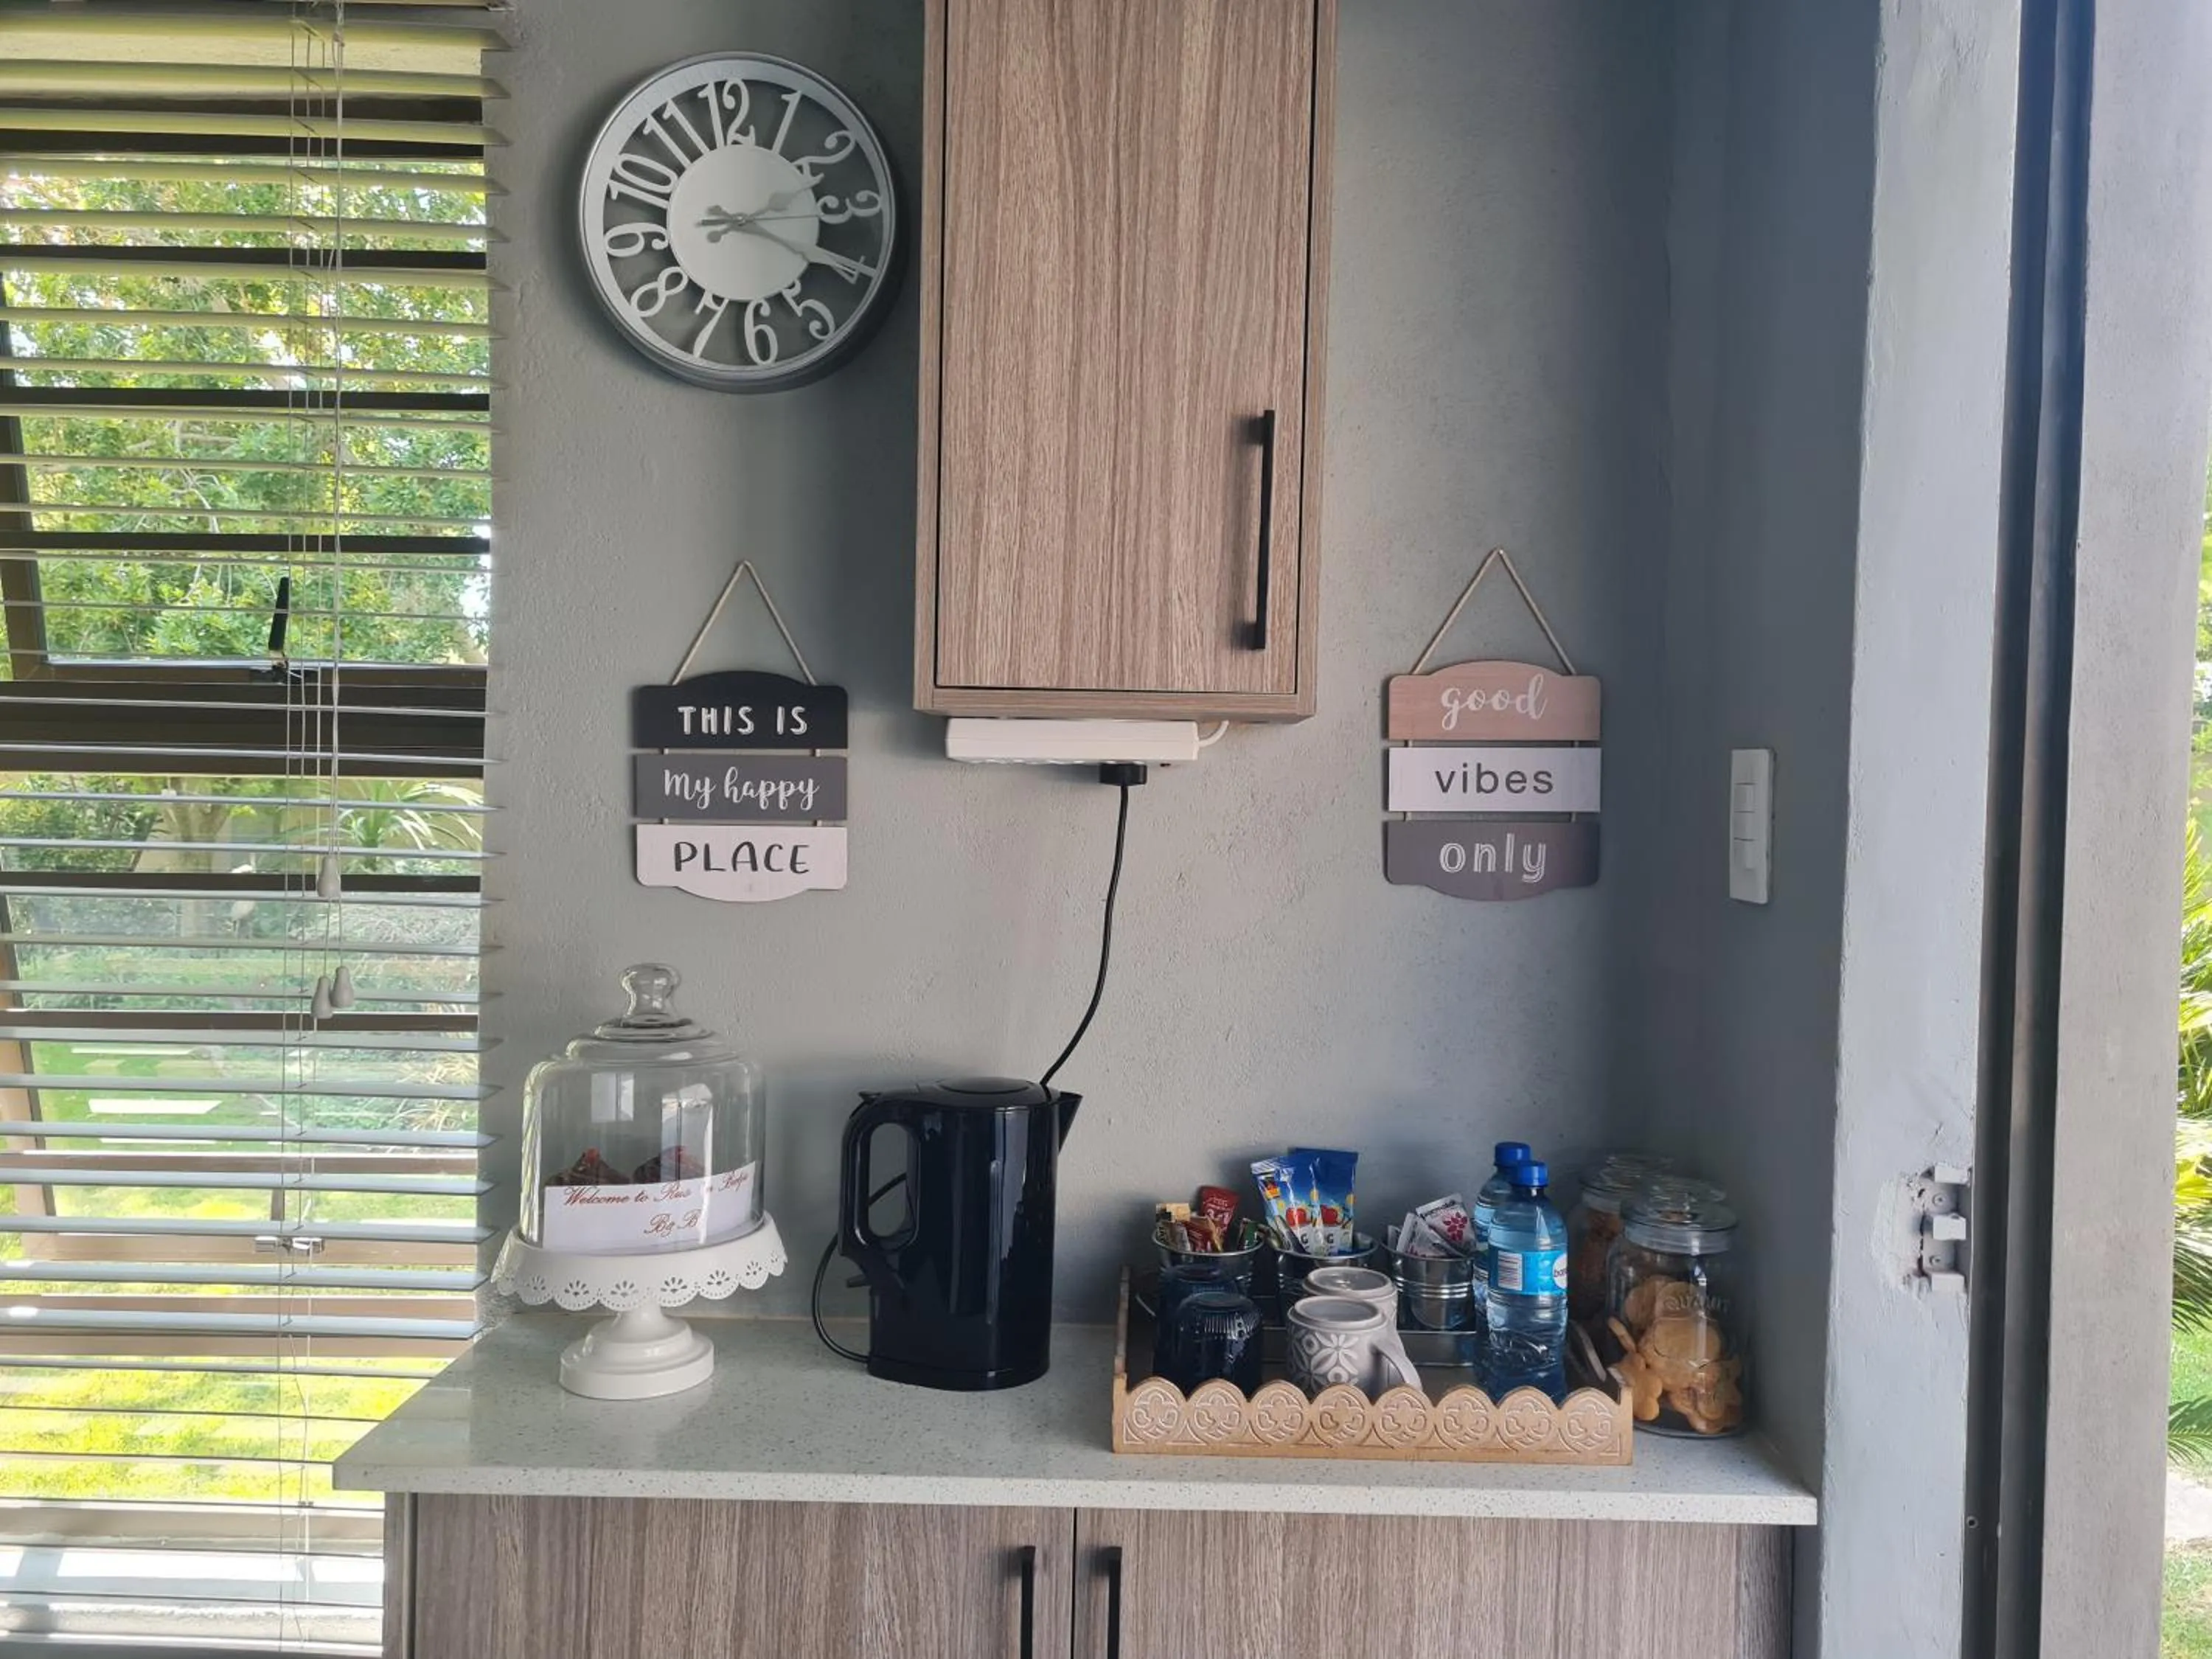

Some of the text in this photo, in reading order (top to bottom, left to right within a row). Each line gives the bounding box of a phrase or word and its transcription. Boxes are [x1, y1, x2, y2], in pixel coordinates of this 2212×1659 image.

[643, 98, 710, 169] 11
[698, 78, 756, 147] 12
[773, 90, 803, 154] 1
[793, 130, 857, 176] 2
[608, 153, 679, 209] 10
[816, 189, 882, 225] 3
[603, 223, 670, 257] 9
[630, 266, 689, 317] 8
[782, 279, 836, 341] 5
[693, 291, 729, 358] 7
[744, 299, 779, 366] 6
[678, 706, 807, 735] THIS IS
[1441, 672, 1548, 730] good
[664, 766, 820, 811] My happy
[1434, 762, 1554, 794] vibes
[673, 841, 810, 874] PLACE
[1439, 832, 1547, 883] only
[563, 1185, 630, 1206] Welcome
[634, 1189, 649, 1203] to
